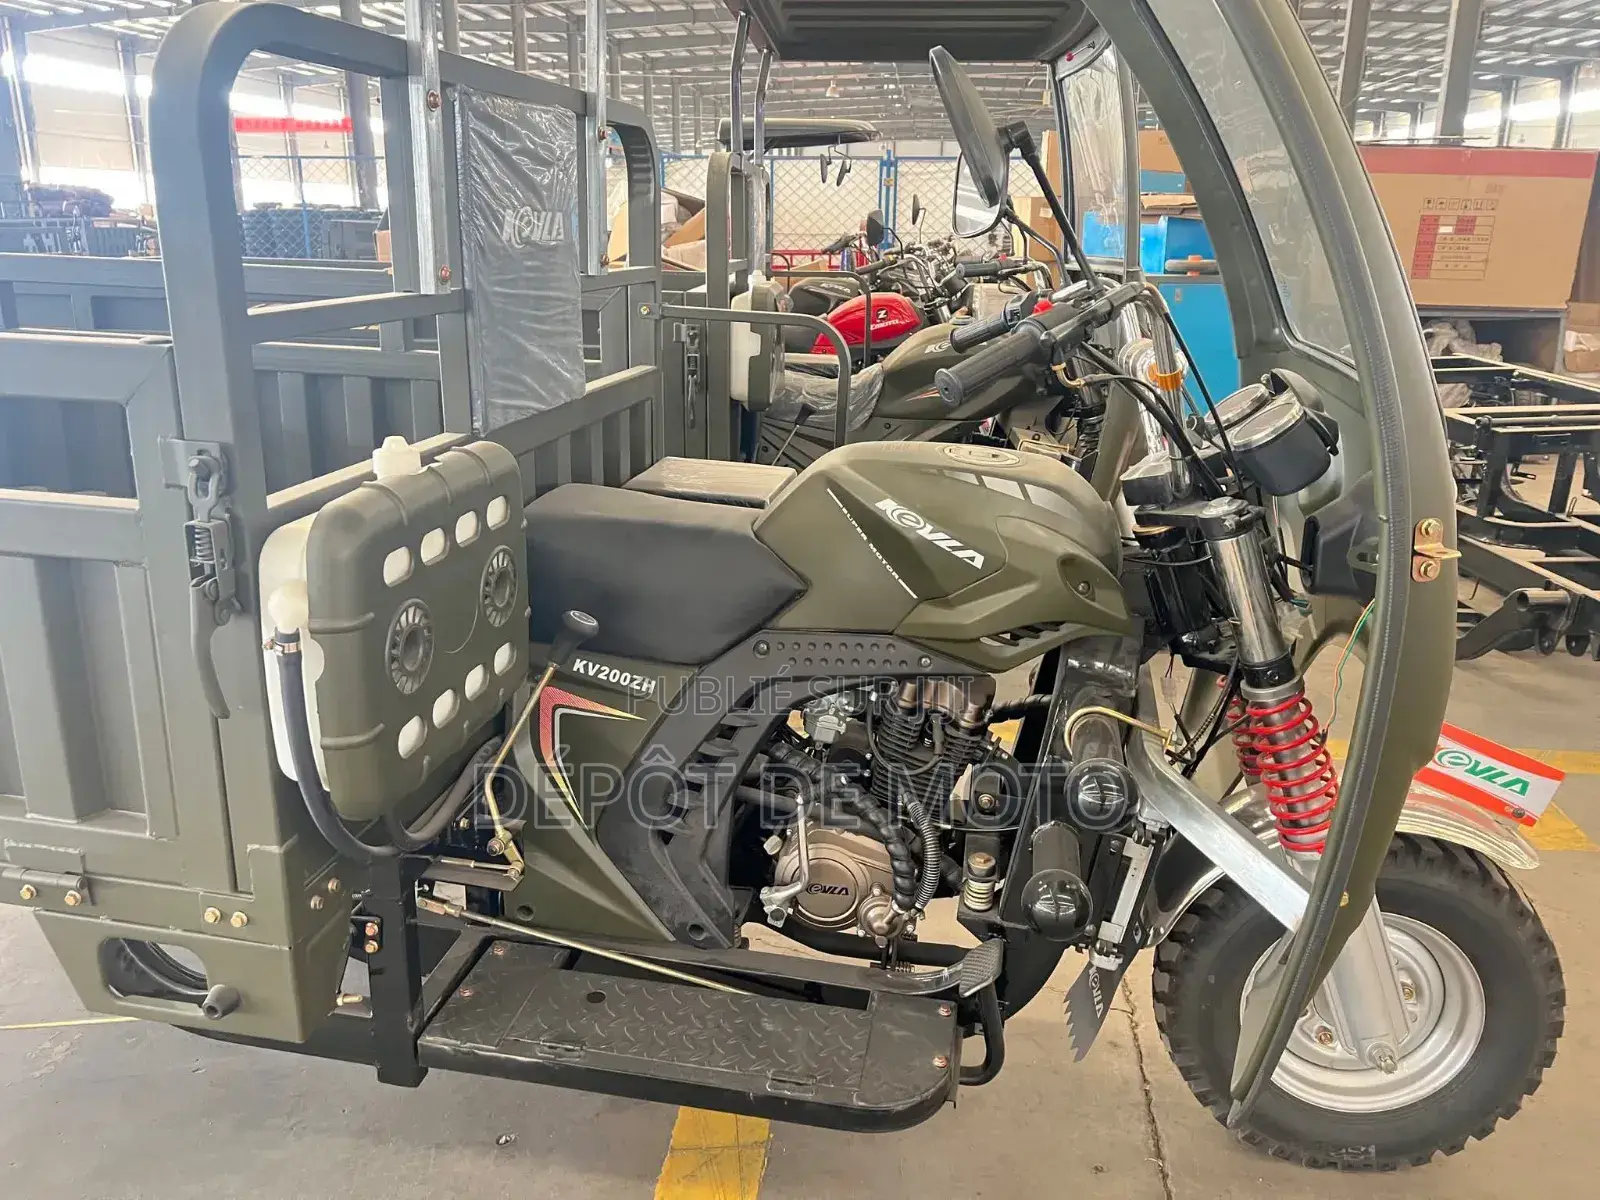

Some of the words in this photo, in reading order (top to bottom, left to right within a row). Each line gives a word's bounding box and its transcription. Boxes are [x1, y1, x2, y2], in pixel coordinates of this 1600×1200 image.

[842, 506, 867, 541] SUPER
[869, 542, 899, 580] MOTOR
[572, 658, 656, 694] KV200ZH
